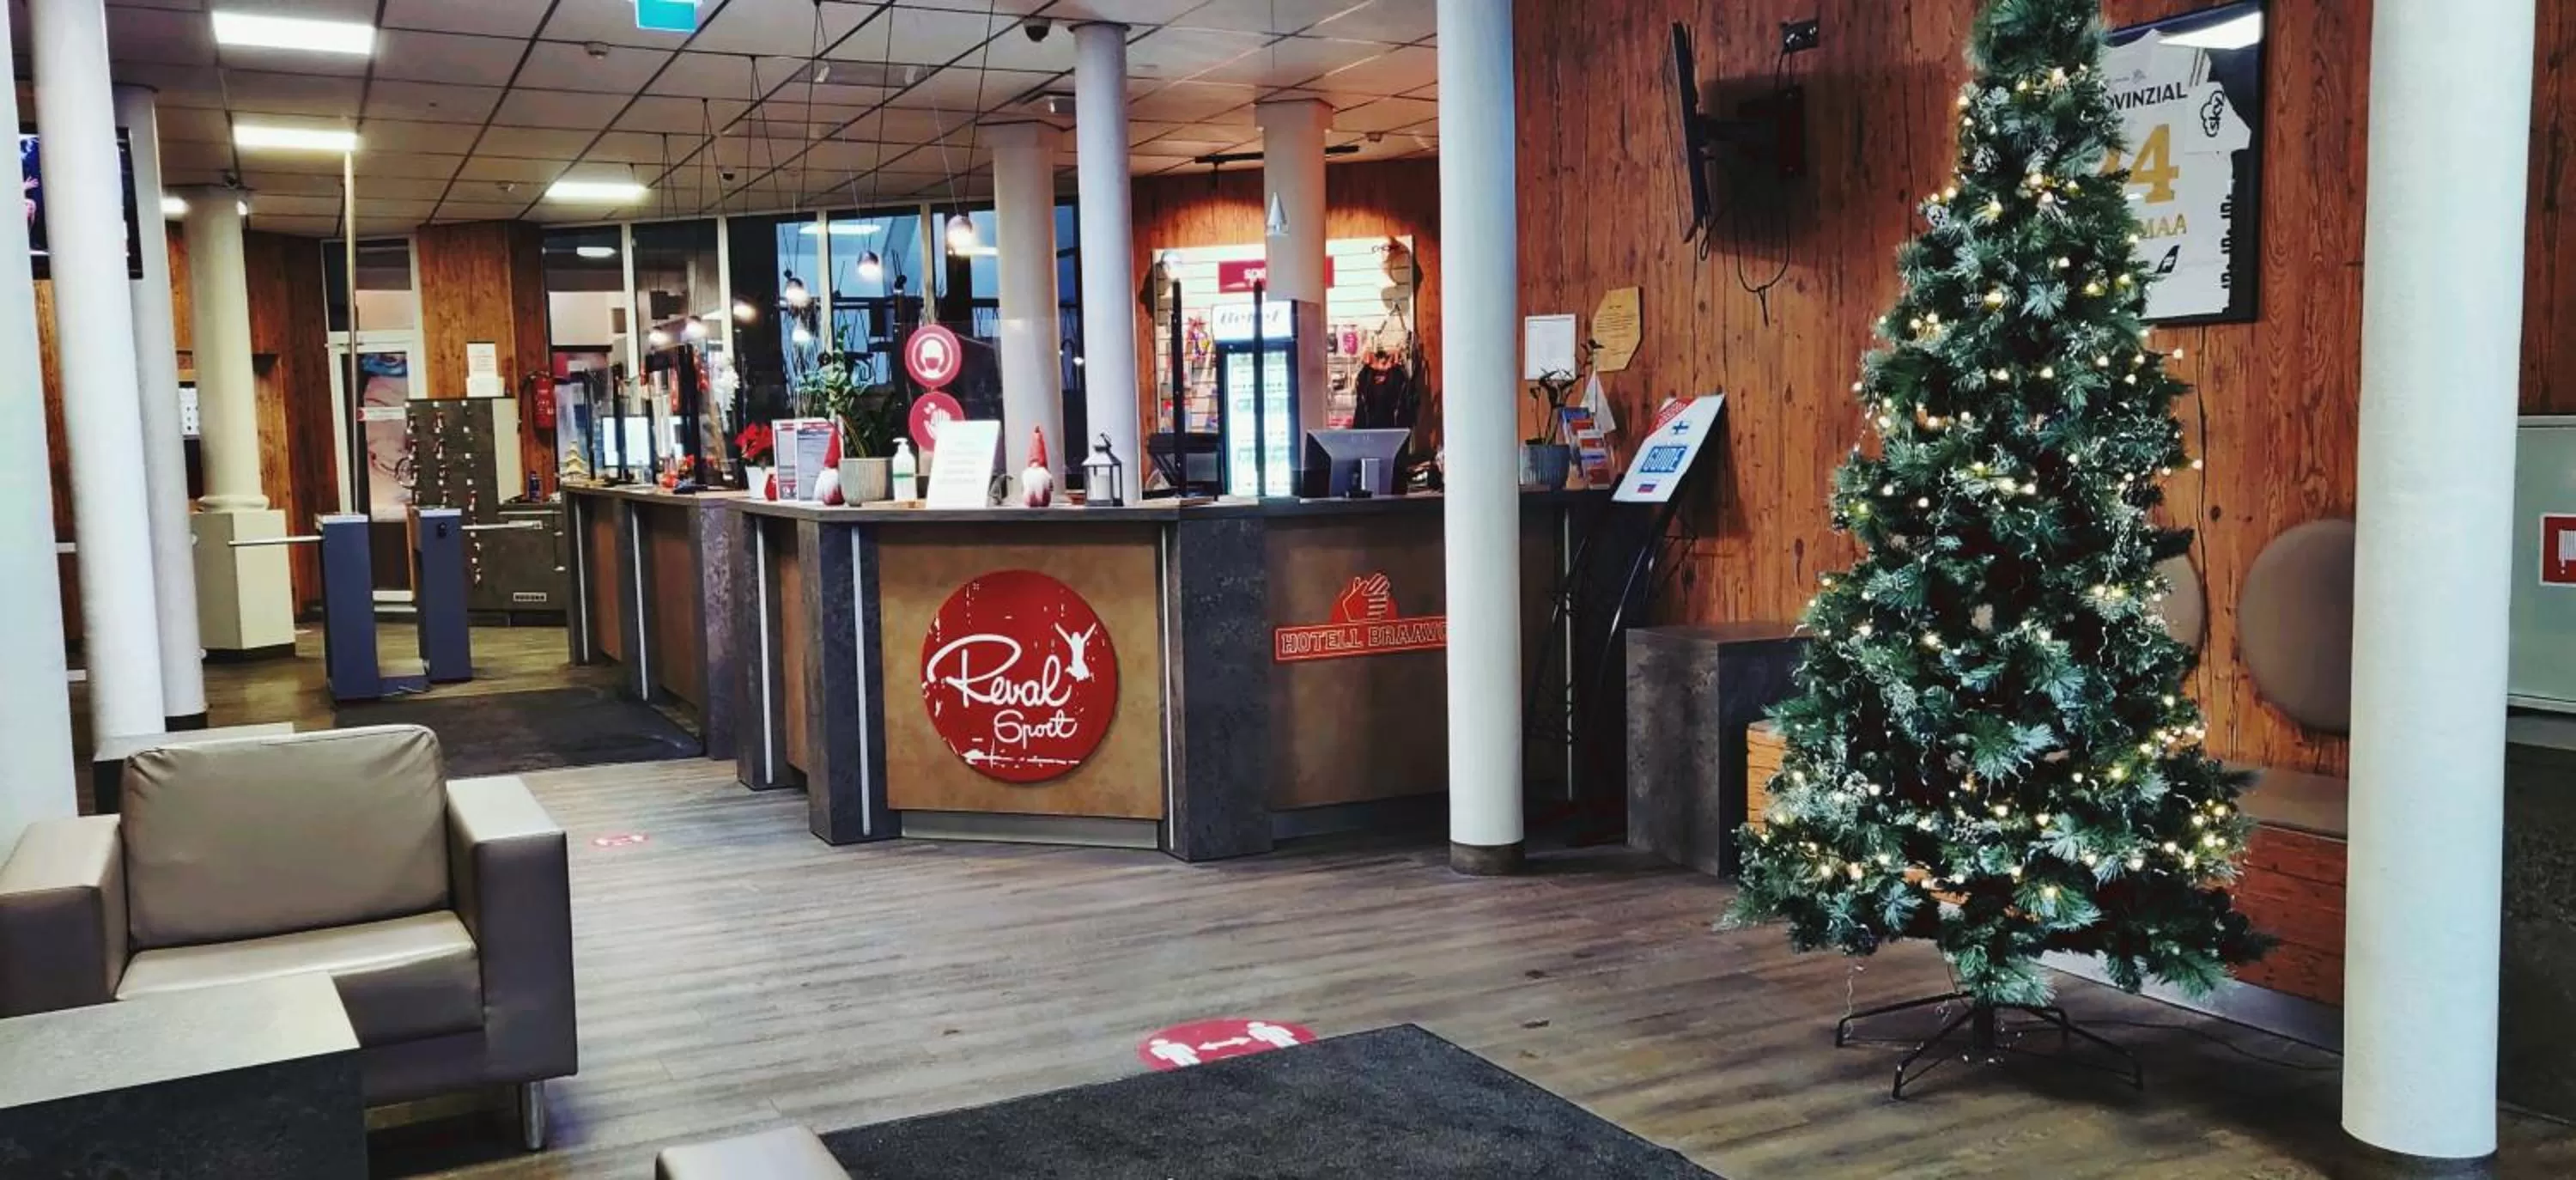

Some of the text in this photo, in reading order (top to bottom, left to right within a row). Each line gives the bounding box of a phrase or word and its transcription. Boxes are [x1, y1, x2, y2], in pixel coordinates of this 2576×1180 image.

[2208, 96, 2225, 129] sky
[1281, 628, 1363, 654] HOTELL
[927, 634, 1072, 708] Reval
[993, 709, 1078, 749] Sport
